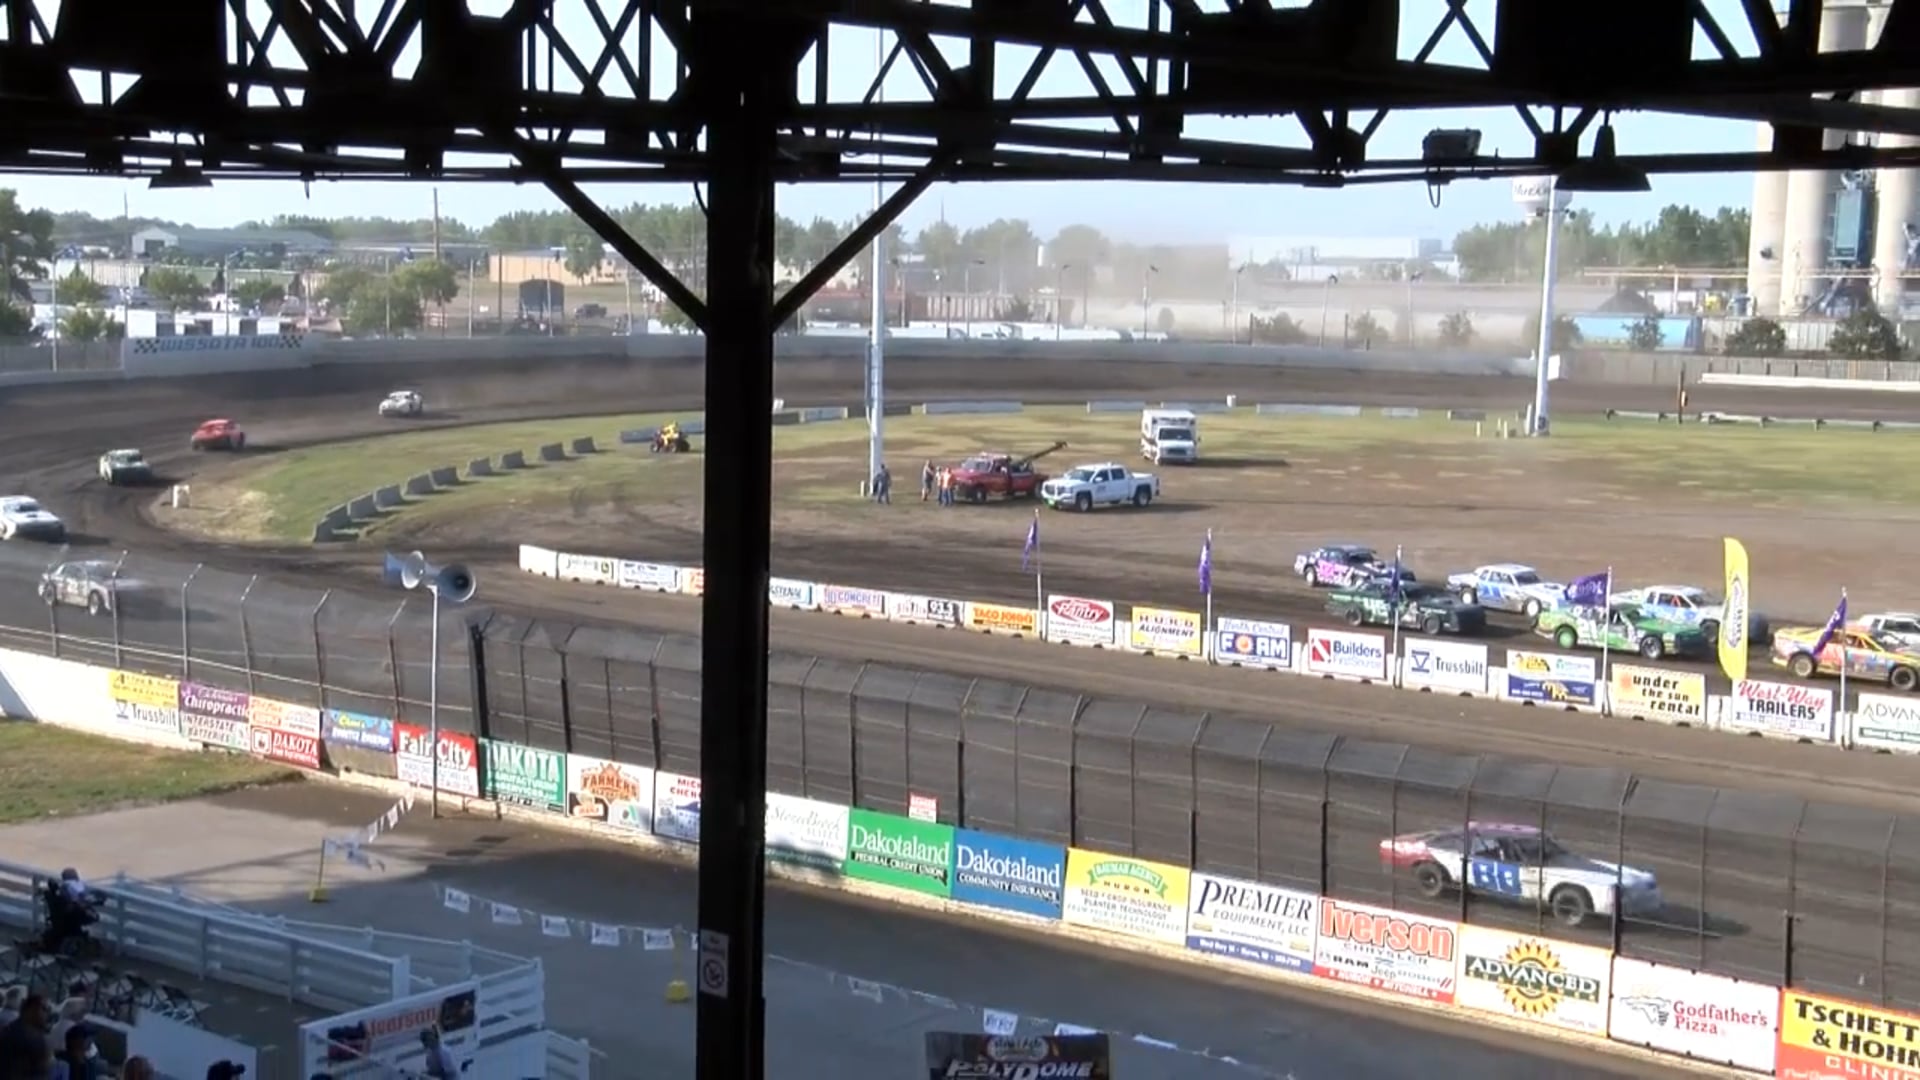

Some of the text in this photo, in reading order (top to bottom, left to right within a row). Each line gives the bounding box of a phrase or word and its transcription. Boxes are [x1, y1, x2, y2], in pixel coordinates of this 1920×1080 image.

[160, 335, 280, 352] WISSOTA 100
[973, 607, 999, 621] TACO
[1058, 600, 1103, 622] Pantry
[1138, 623, 1195, 638] ALIGNMENT
[1220, 631, 1288, 660] FOAM
[1333, 640, 1383, 659] Builders
[1435, 655, 1485, 676] Trussbilt
[1632, 675, 1679, 690] under
[184, 694, 250, 718] Chiropractic
[1641, 688, 1690, 702] the sun
[1738, 680, 1826, 712] West-Way
[131, 703, 177, 727] Trussbilt
[1649, 698, 1700, 717] rental
[1749, 698, 1816, 721] TRAILERS
[1863, 702, 1920, 723] ADVAN
[272, 731, 319, 758] DAKOTA
[398, 729, 433, 758] Fair
[436, 737, 472, 772] City
[851, 824, 950, 866] Dakotaland
[854, 851, 889, 867] FEDERAL
[889, 858, 918, 874] CREDIT
[918, 863, 944, 880] UNION
[956, 844, 1061, 889] Dakotaland
[959, 872, 1058, 902] COMMUNITY INSURANCE
[1103, 880, 1150, 894] HURON
[1081, 888, 1099, 898] SEED
[1129, 897, 1172, 912] INSURANCE
[1084, 898, 1168, 920] PLANTER TECHNOLOGY
[1194, 878, 1313, 922] PREMIER
[1212, 908, 1284, 935] EQUIPMENT,
[1287, 923, 1310, 937] LLC
[1319, 901, 1454, 962] Iverson
[1332, 955, 1370, 969] RAM
[1343, 942, 1429, 966] CHRYSLER
[1370, 965, 1397, 981] Jeep
[1468, 957, 1598, 994] ADVANCED
[1673, 1000, 1768, 1027] Godfather's
[1674, 1015, 1718, 1036] Pizza
[1811, 1028, 1832, 1049] &
